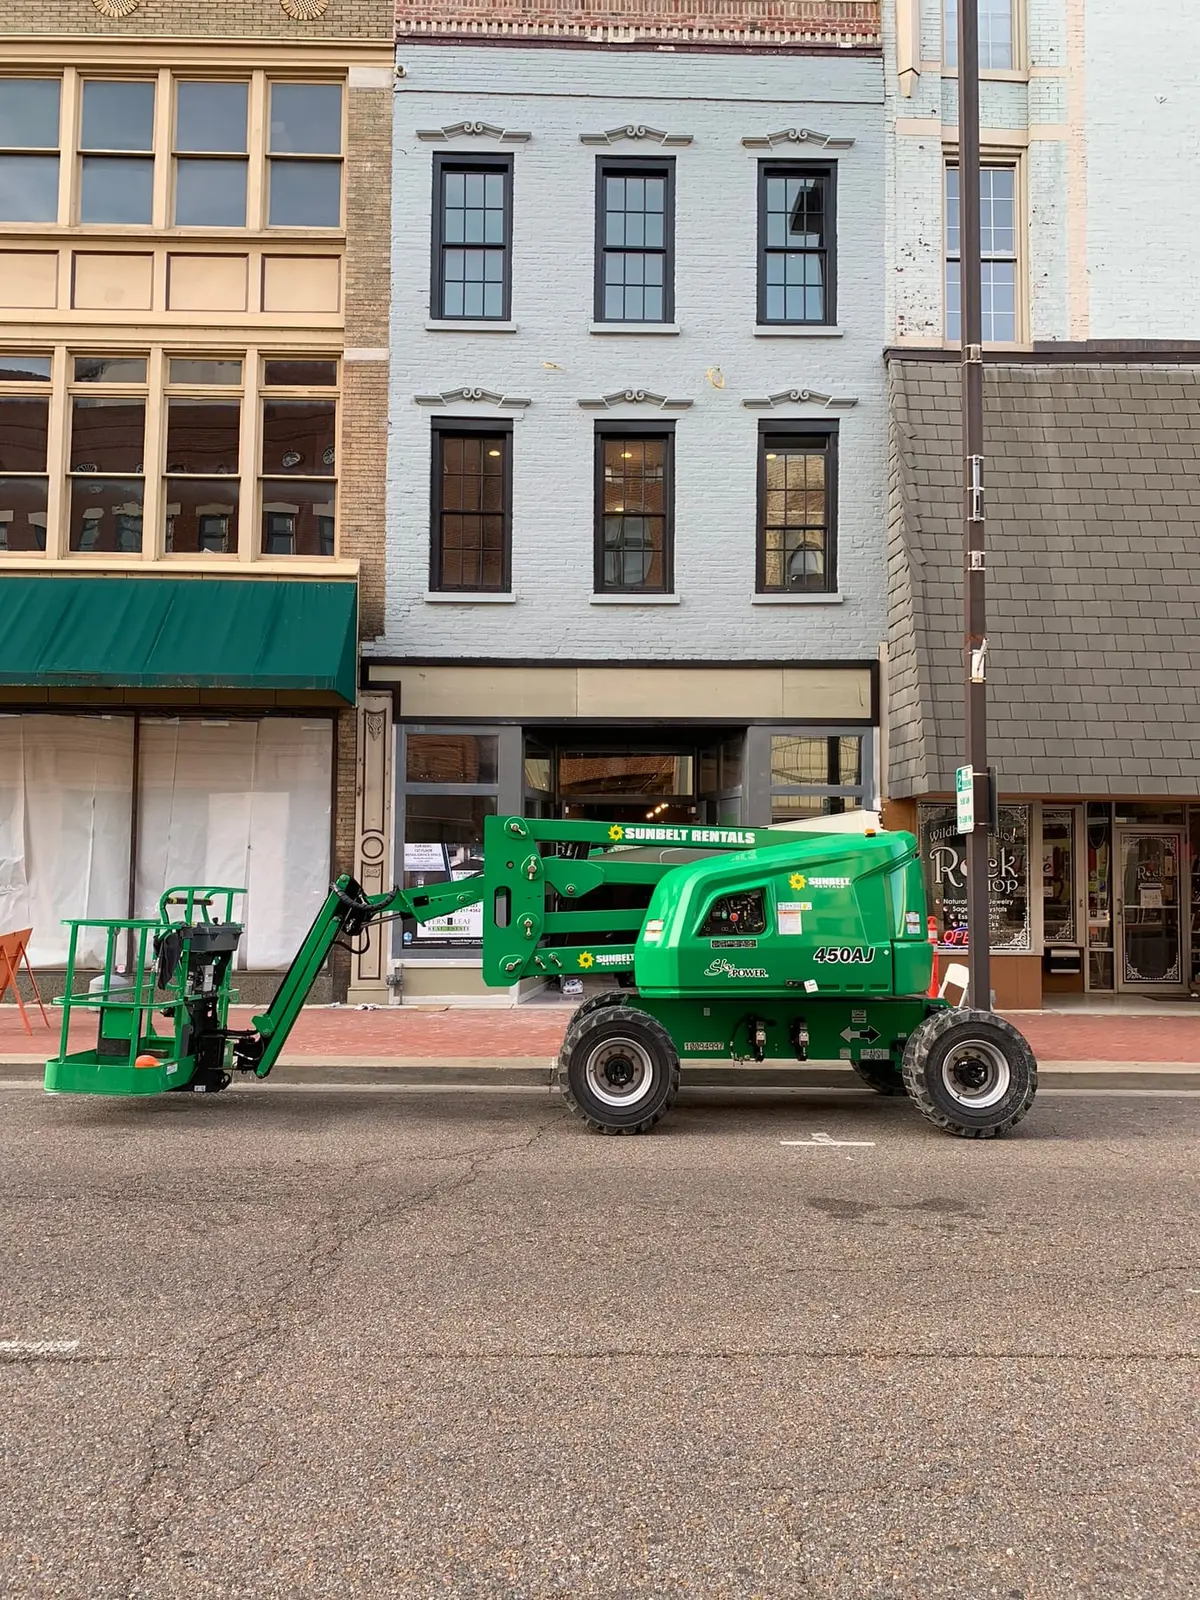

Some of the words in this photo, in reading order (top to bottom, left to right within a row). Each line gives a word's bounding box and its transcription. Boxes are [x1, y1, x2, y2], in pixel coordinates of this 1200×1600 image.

[625, 828, 688, 840] SUNBELT
[692, 830, 755, 844] RENTALS
[808, 877, 850, 885] SUNBELT
[943, 930, 968, 944] OPE
[596, 954, 634, 963] SUNBELT
[813, 946, 875, 963] 450AJ
